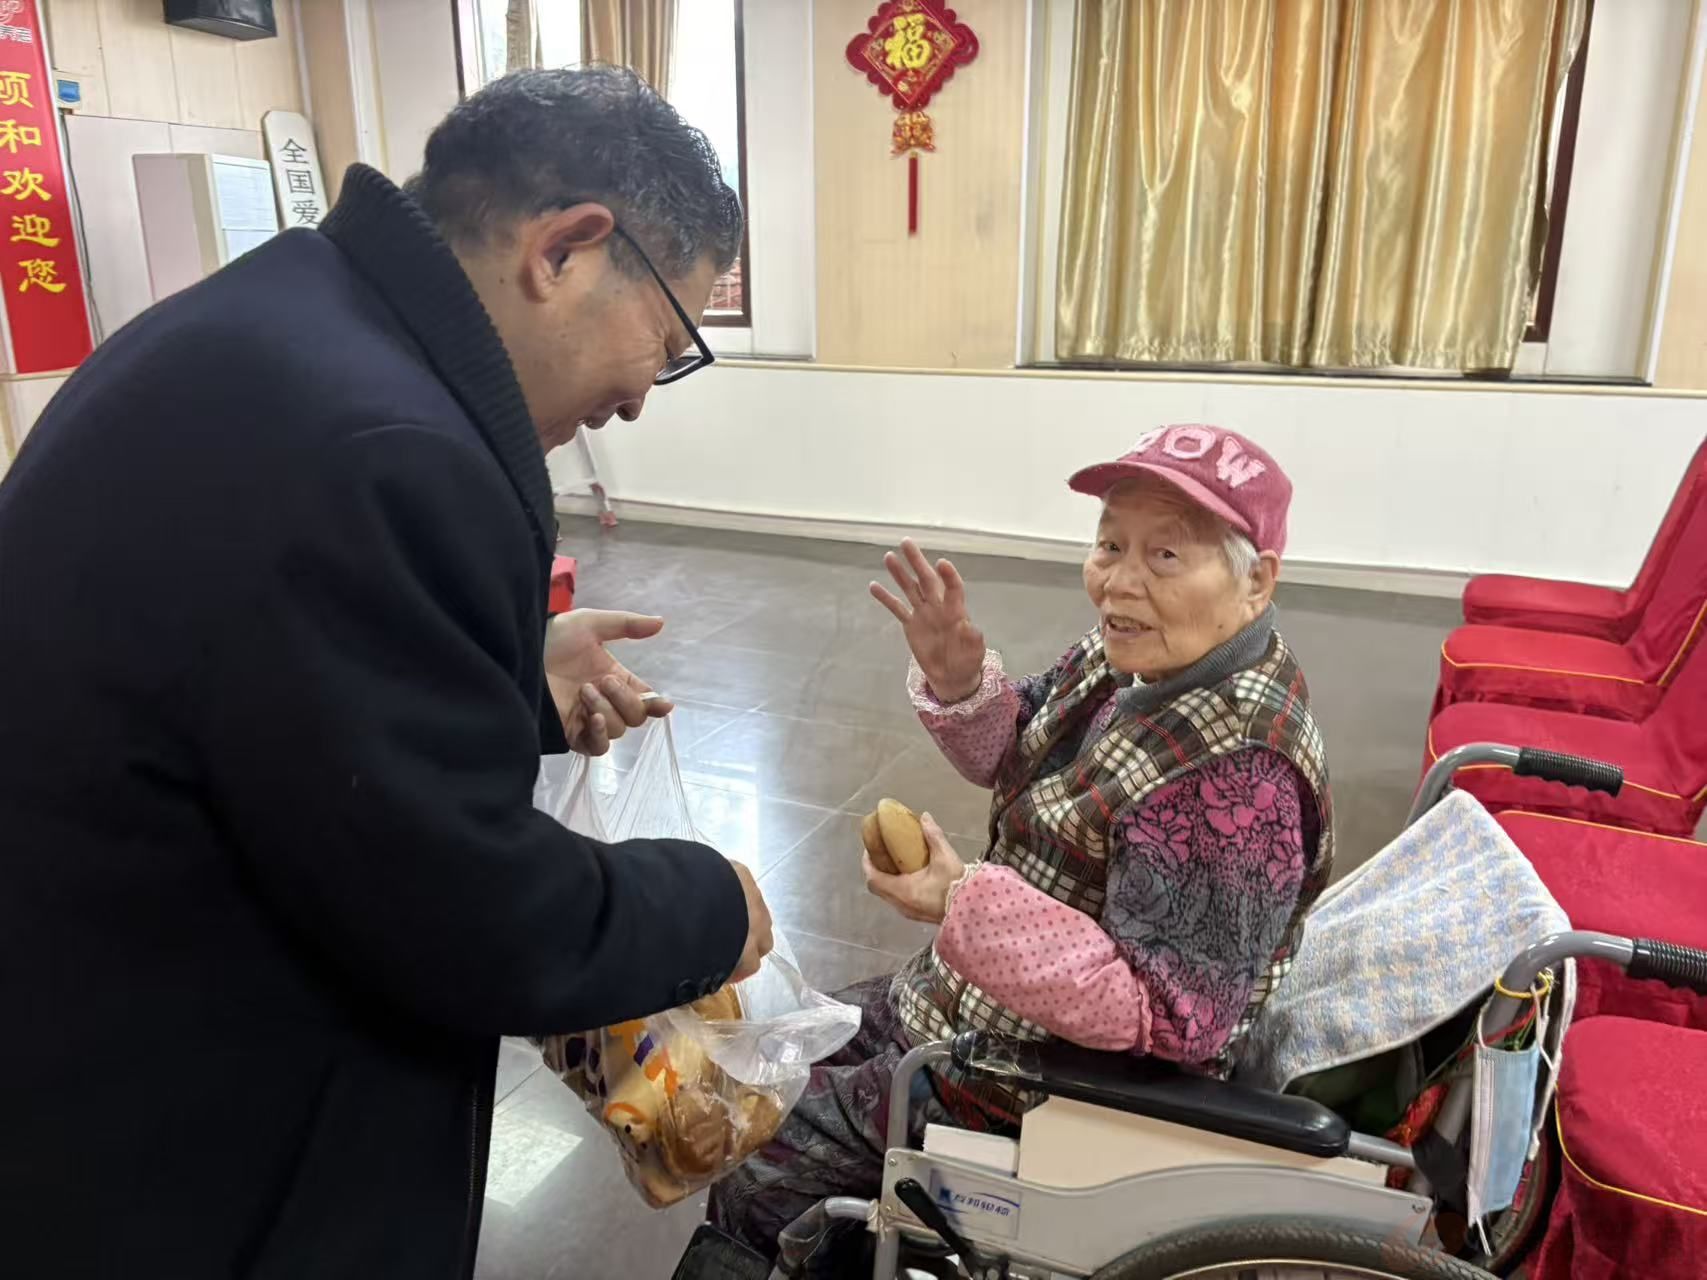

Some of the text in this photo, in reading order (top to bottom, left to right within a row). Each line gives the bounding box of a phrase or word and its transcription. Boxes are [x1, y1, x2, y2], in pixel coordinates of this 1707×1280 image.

[884, 13, 931, 69] 福
[279, 138, 320, 225] 全国爱
